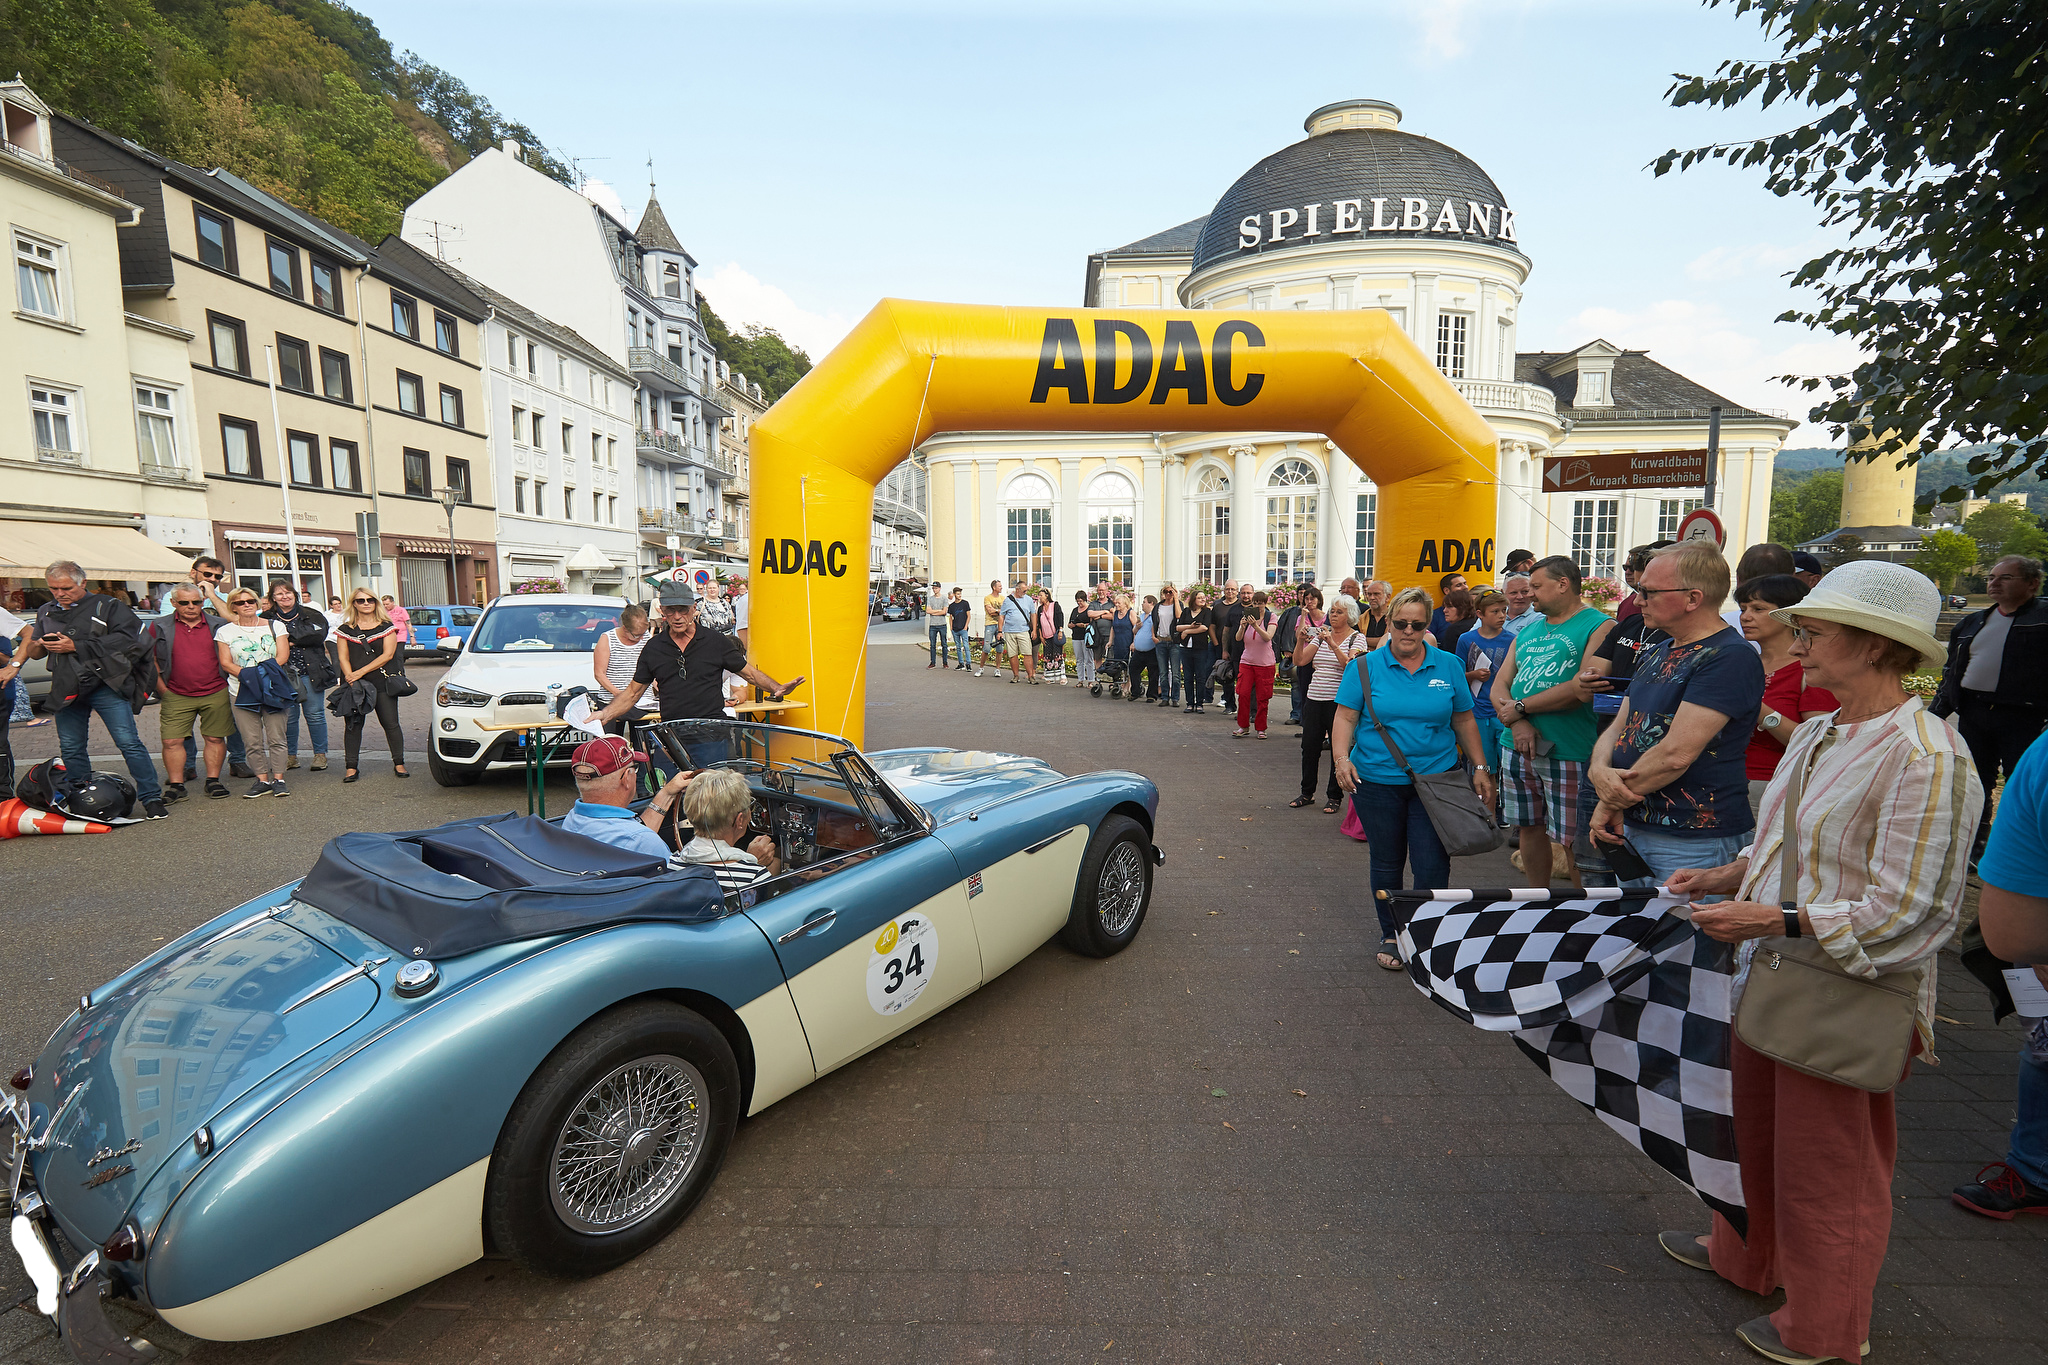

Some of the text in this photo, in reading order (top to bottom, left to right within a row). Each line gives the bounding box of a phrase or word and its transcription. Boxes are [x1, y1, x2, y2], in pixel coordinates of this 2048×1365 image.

[1239, 197, 1519, 250] SPIELBANK
[1029, 317, 1266, 407] ADAC
[1589, 472, 1701, 488] Kurpark Bismarckhöhe
[1630, 455, 1702, 470] Kurwaldbahn
[266, 556, 284, 568] 130
[760, 538, 848, 578] ADAC
[1415, 537, 1494, 573] ADAC
[880, 927, 895, 947] 10
[883, 942, 925, 995] 34
